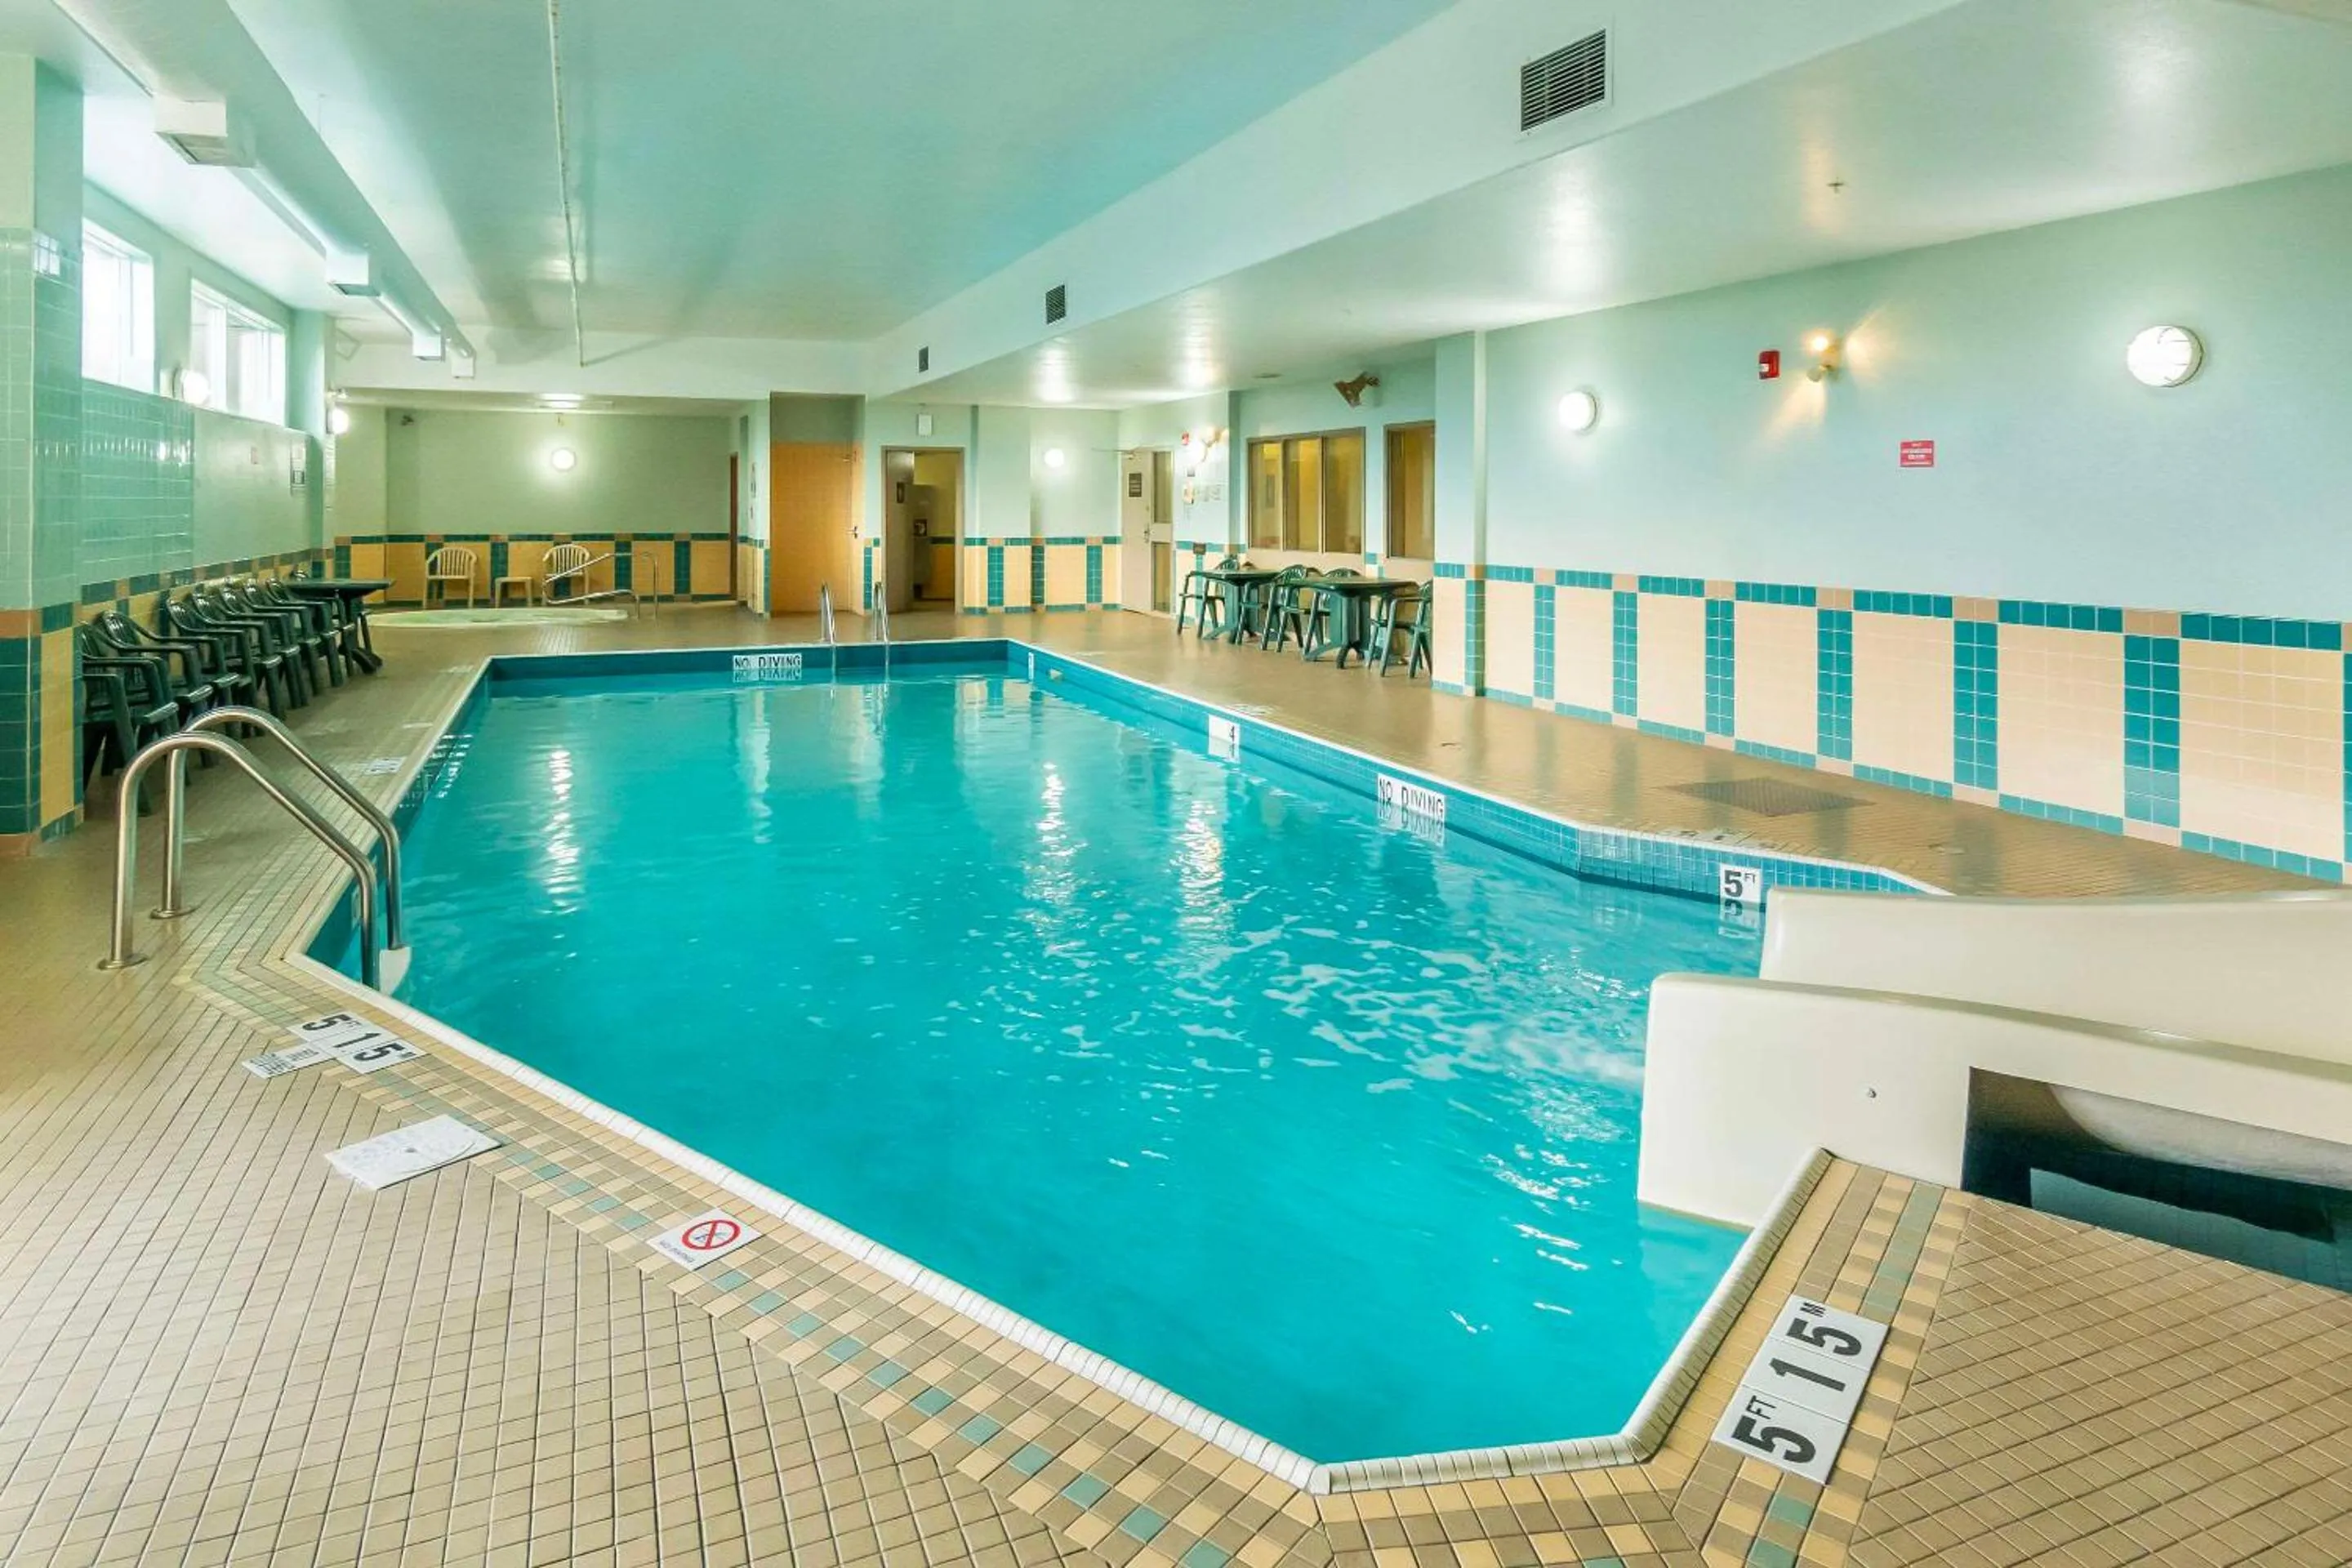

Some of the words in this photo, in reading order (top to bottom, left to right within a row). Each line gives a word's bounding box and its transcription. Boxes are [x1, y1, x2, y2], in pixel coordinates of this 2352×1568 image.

[734, 657, 750, 668] NO
[758, 655, 801, 668] DIVING
[1379, 777, 1393, 802] NO
[1401, 786, 1444, 818] DIVING
[1723, 870, 1744, 898] 5
[1731, 1414, 1817, 1464] 5
